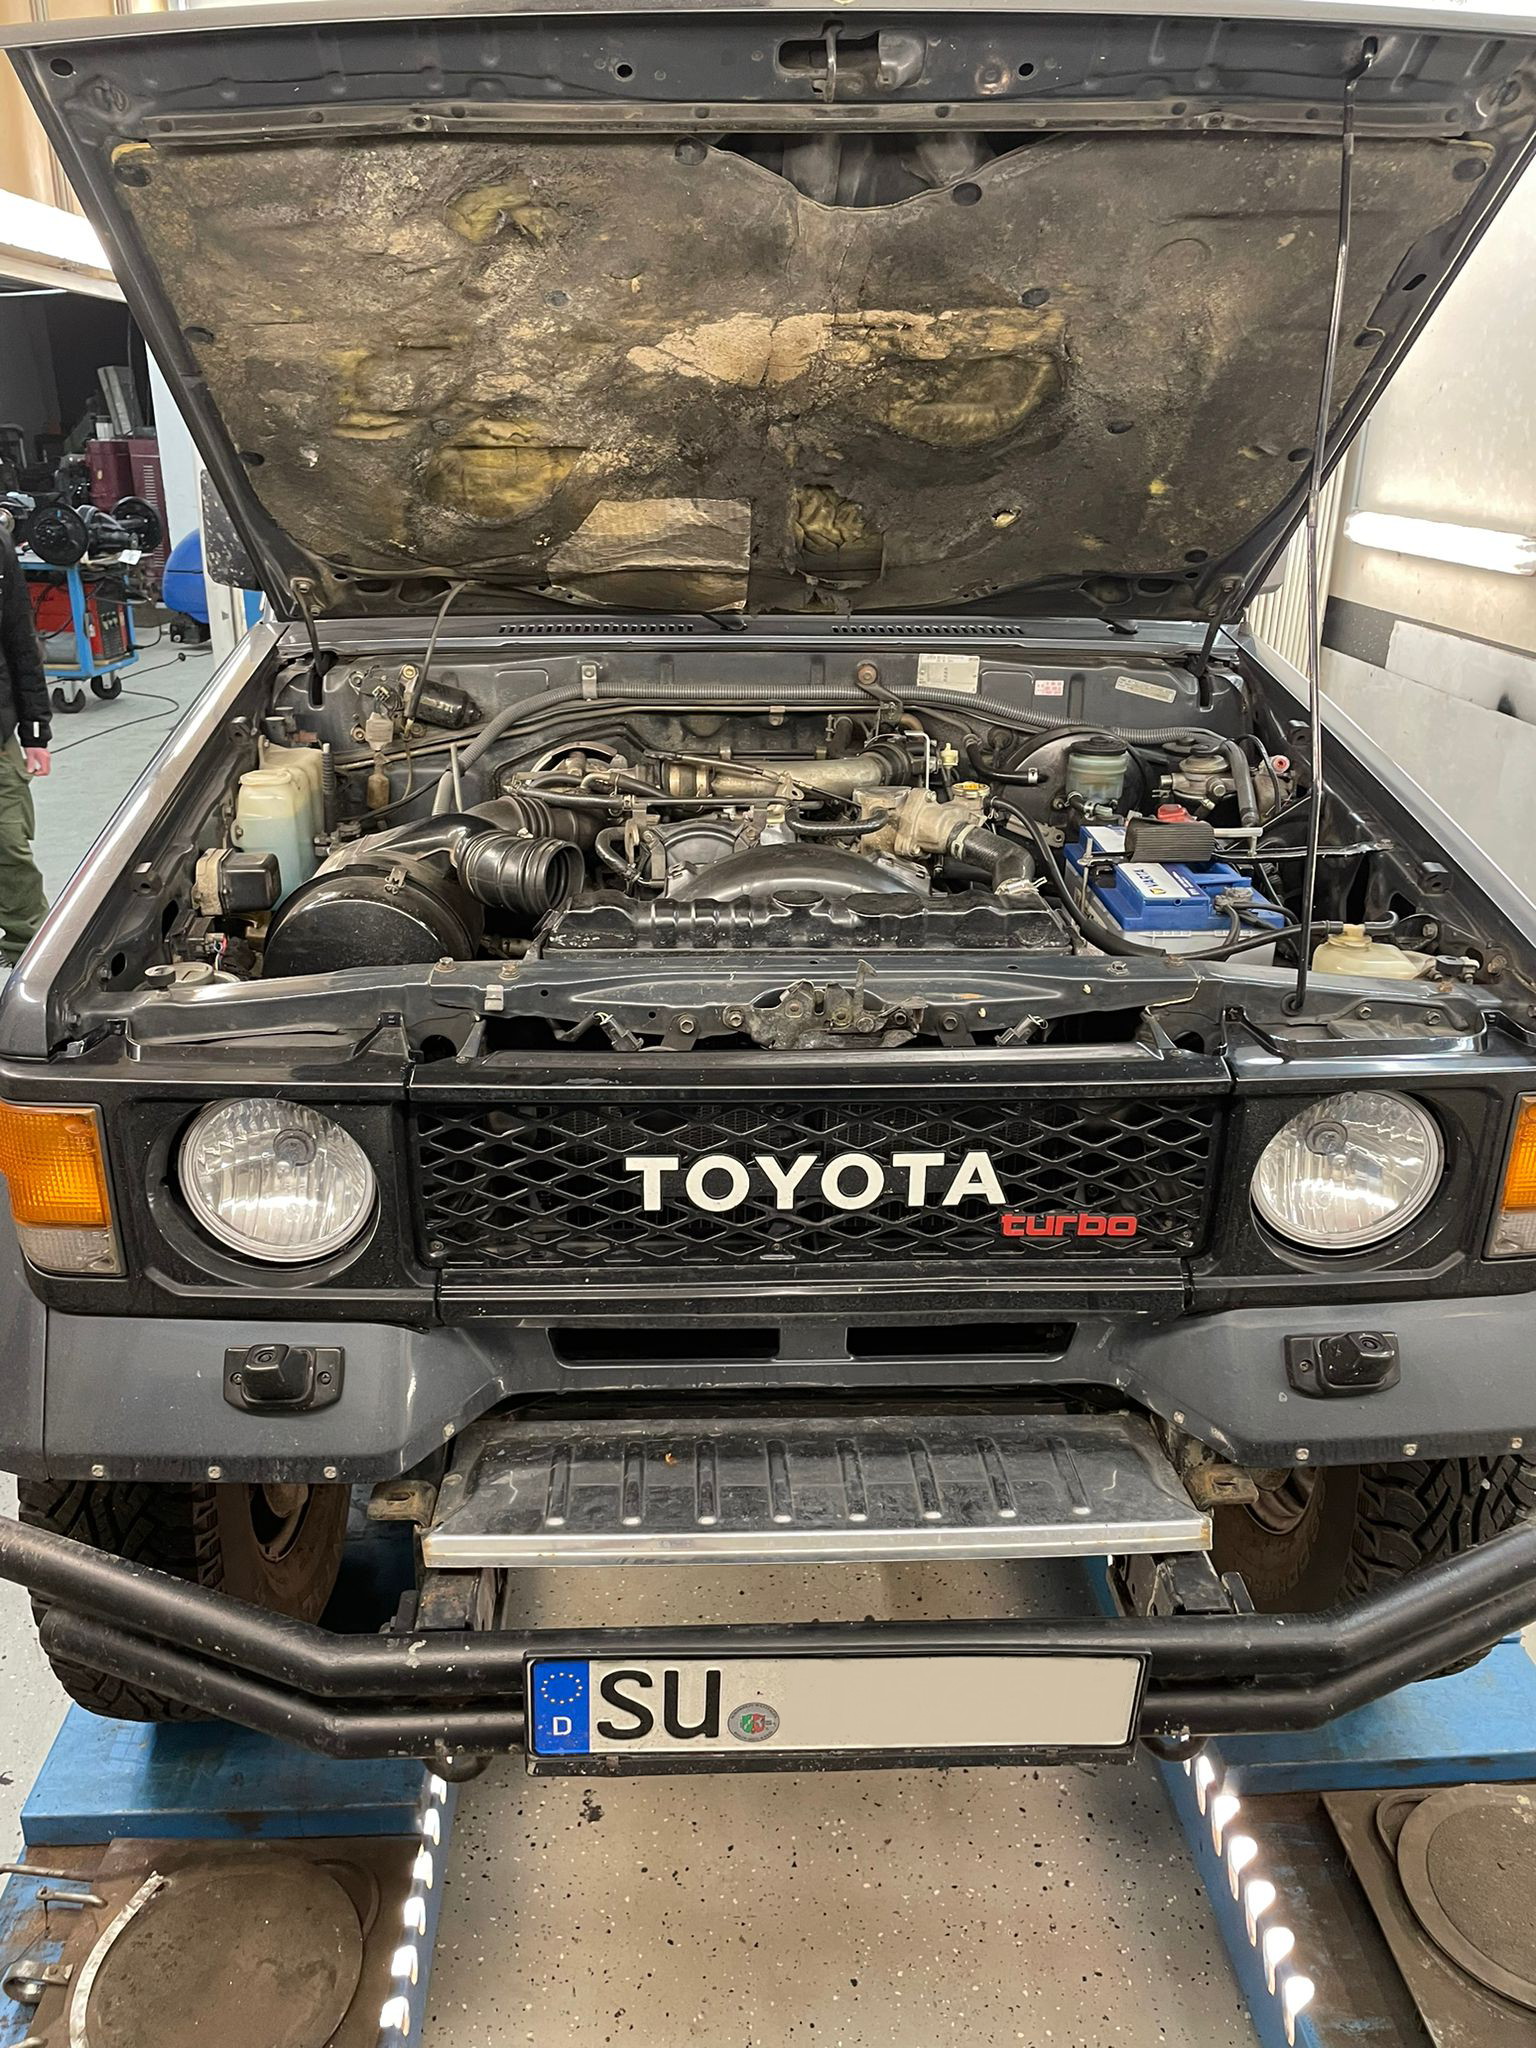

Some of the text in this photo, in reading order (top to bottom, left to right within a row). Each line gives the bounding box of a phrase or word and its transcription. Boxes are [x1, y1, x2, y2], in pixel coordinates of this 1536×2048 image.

[625, 1151, 1006, 1211] TOYOTA
[1001, 1212, 1138, 1237] turbo
[597, 1669, 720, 1740] SU
[552, 1716, 572, 1736] D
